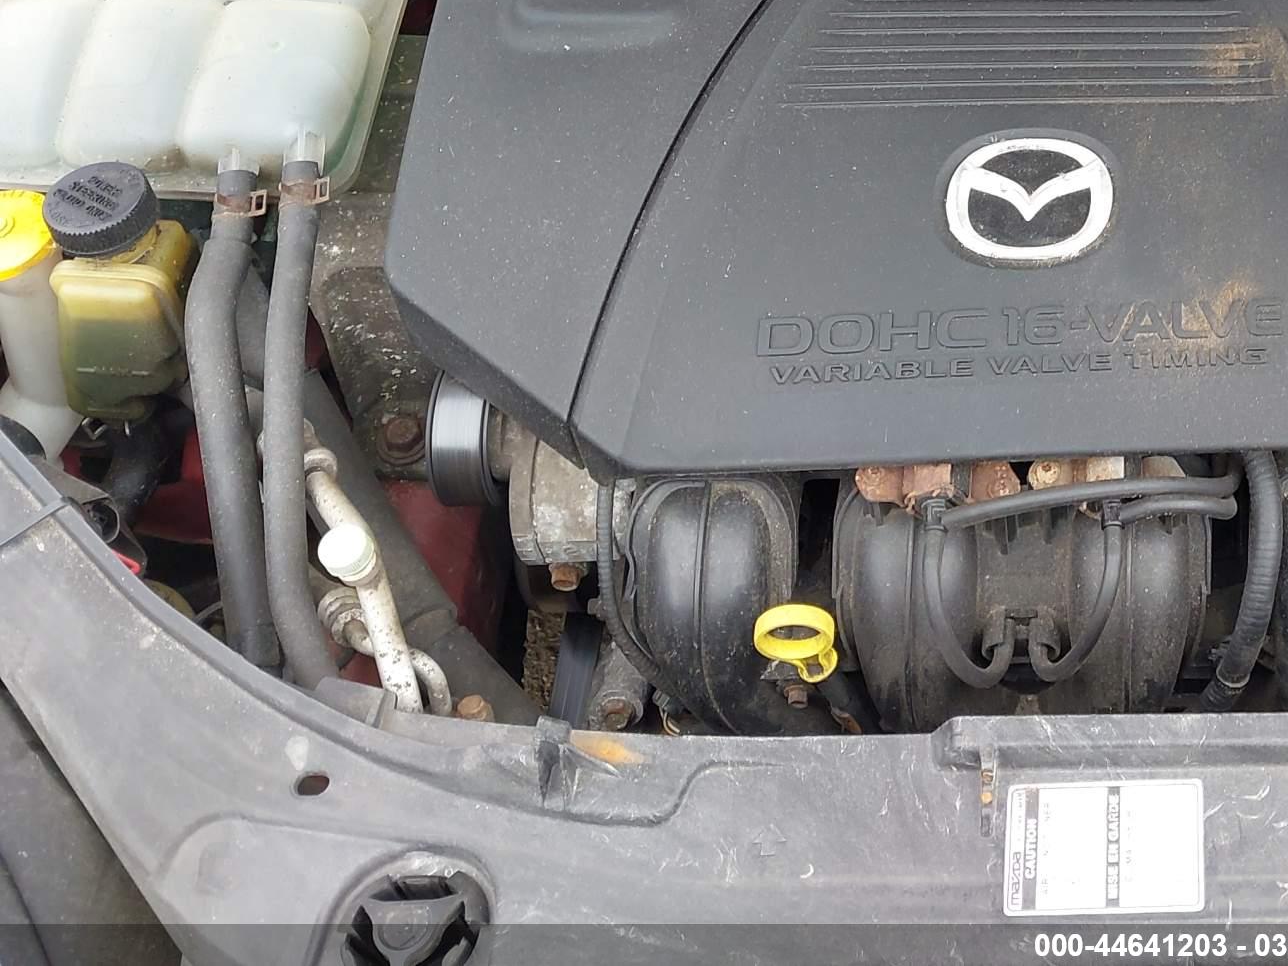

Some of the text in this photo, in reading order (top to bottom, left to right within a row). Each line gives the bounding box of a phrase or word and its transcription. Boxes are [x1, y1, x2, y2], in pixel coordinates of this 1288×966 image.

[756, 297, 1284, 358] DOHC 16-VALVE
[769, 347, 1270, 385] VARIABLE VALVE TIMING
[1024, 818, 1038, 880] CAUTION
[1107, 793, 1120, 901] MISE EN GARDE
